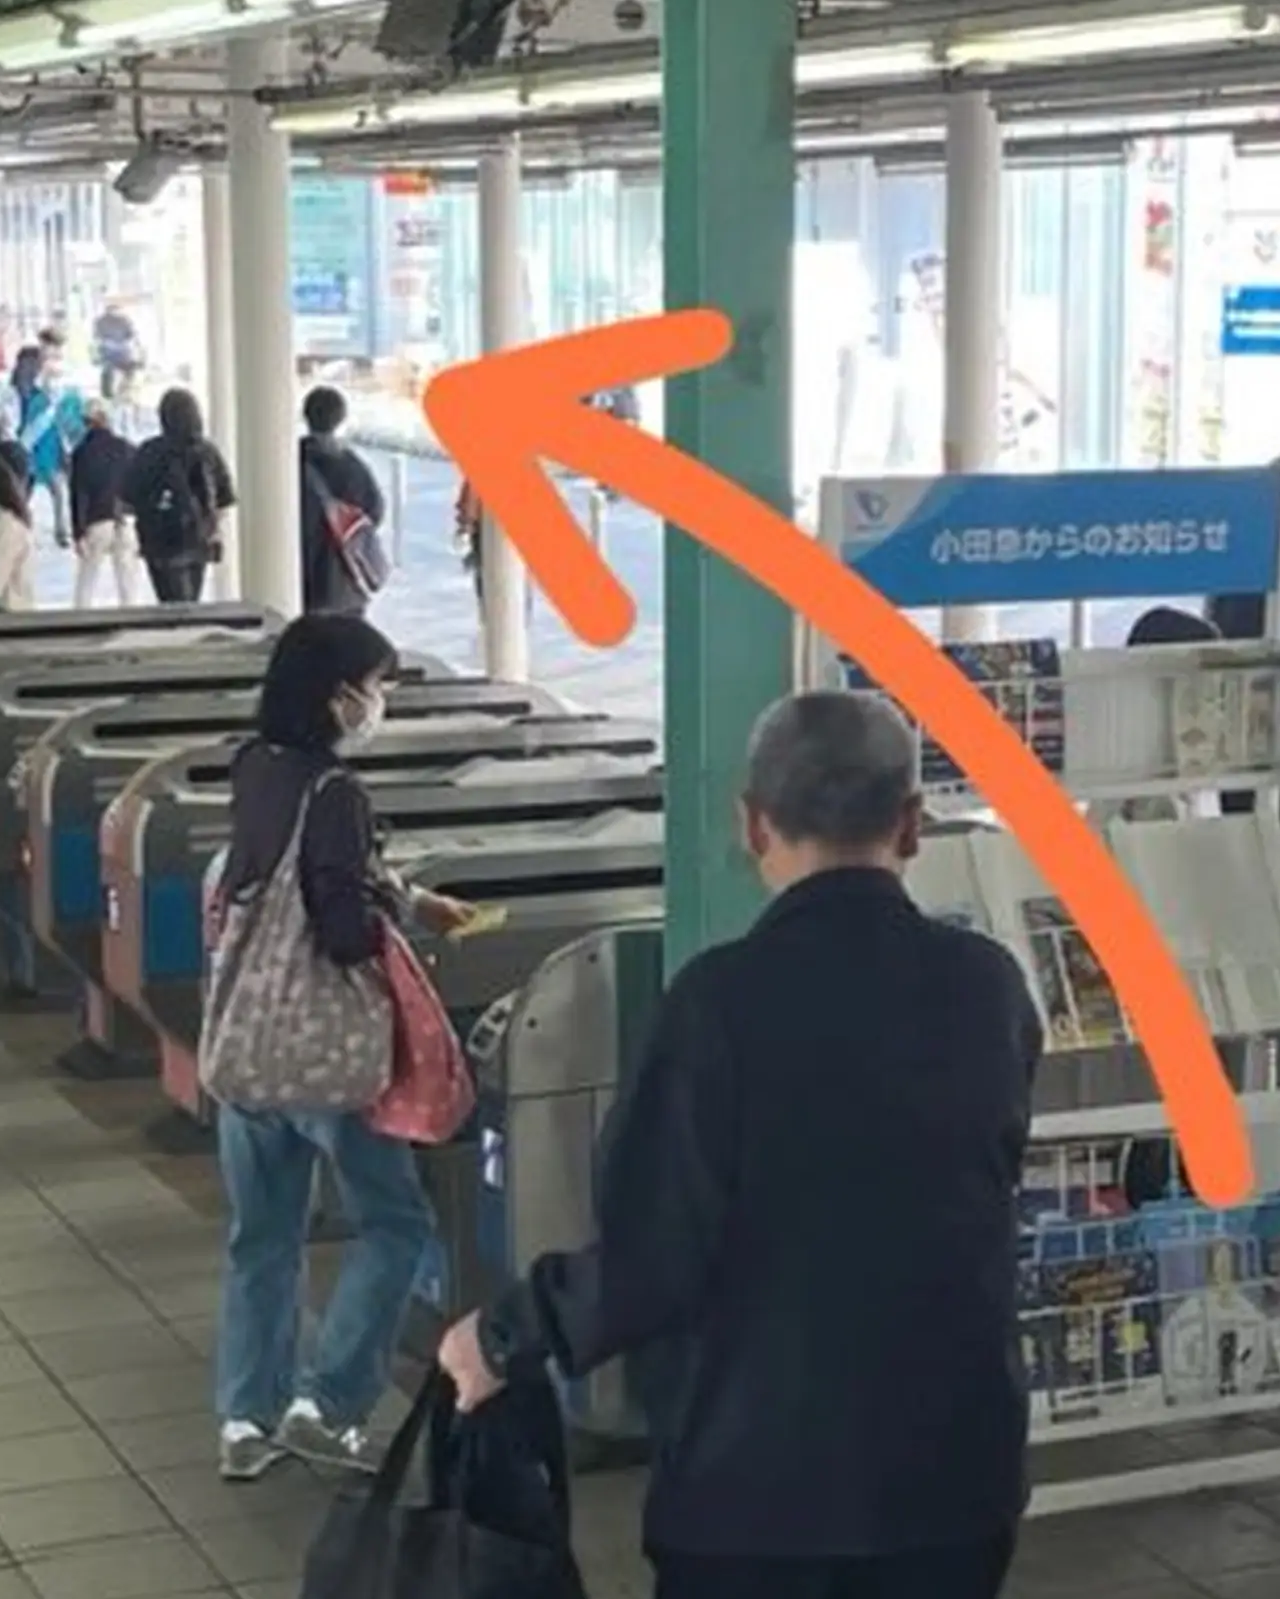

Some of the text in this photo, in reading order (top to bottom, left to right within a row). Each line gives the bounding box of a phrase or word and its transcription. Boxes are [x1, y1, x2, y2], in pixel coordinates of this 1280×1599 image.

[930, 519, 1229, 565] 小田急からのお知らせ
